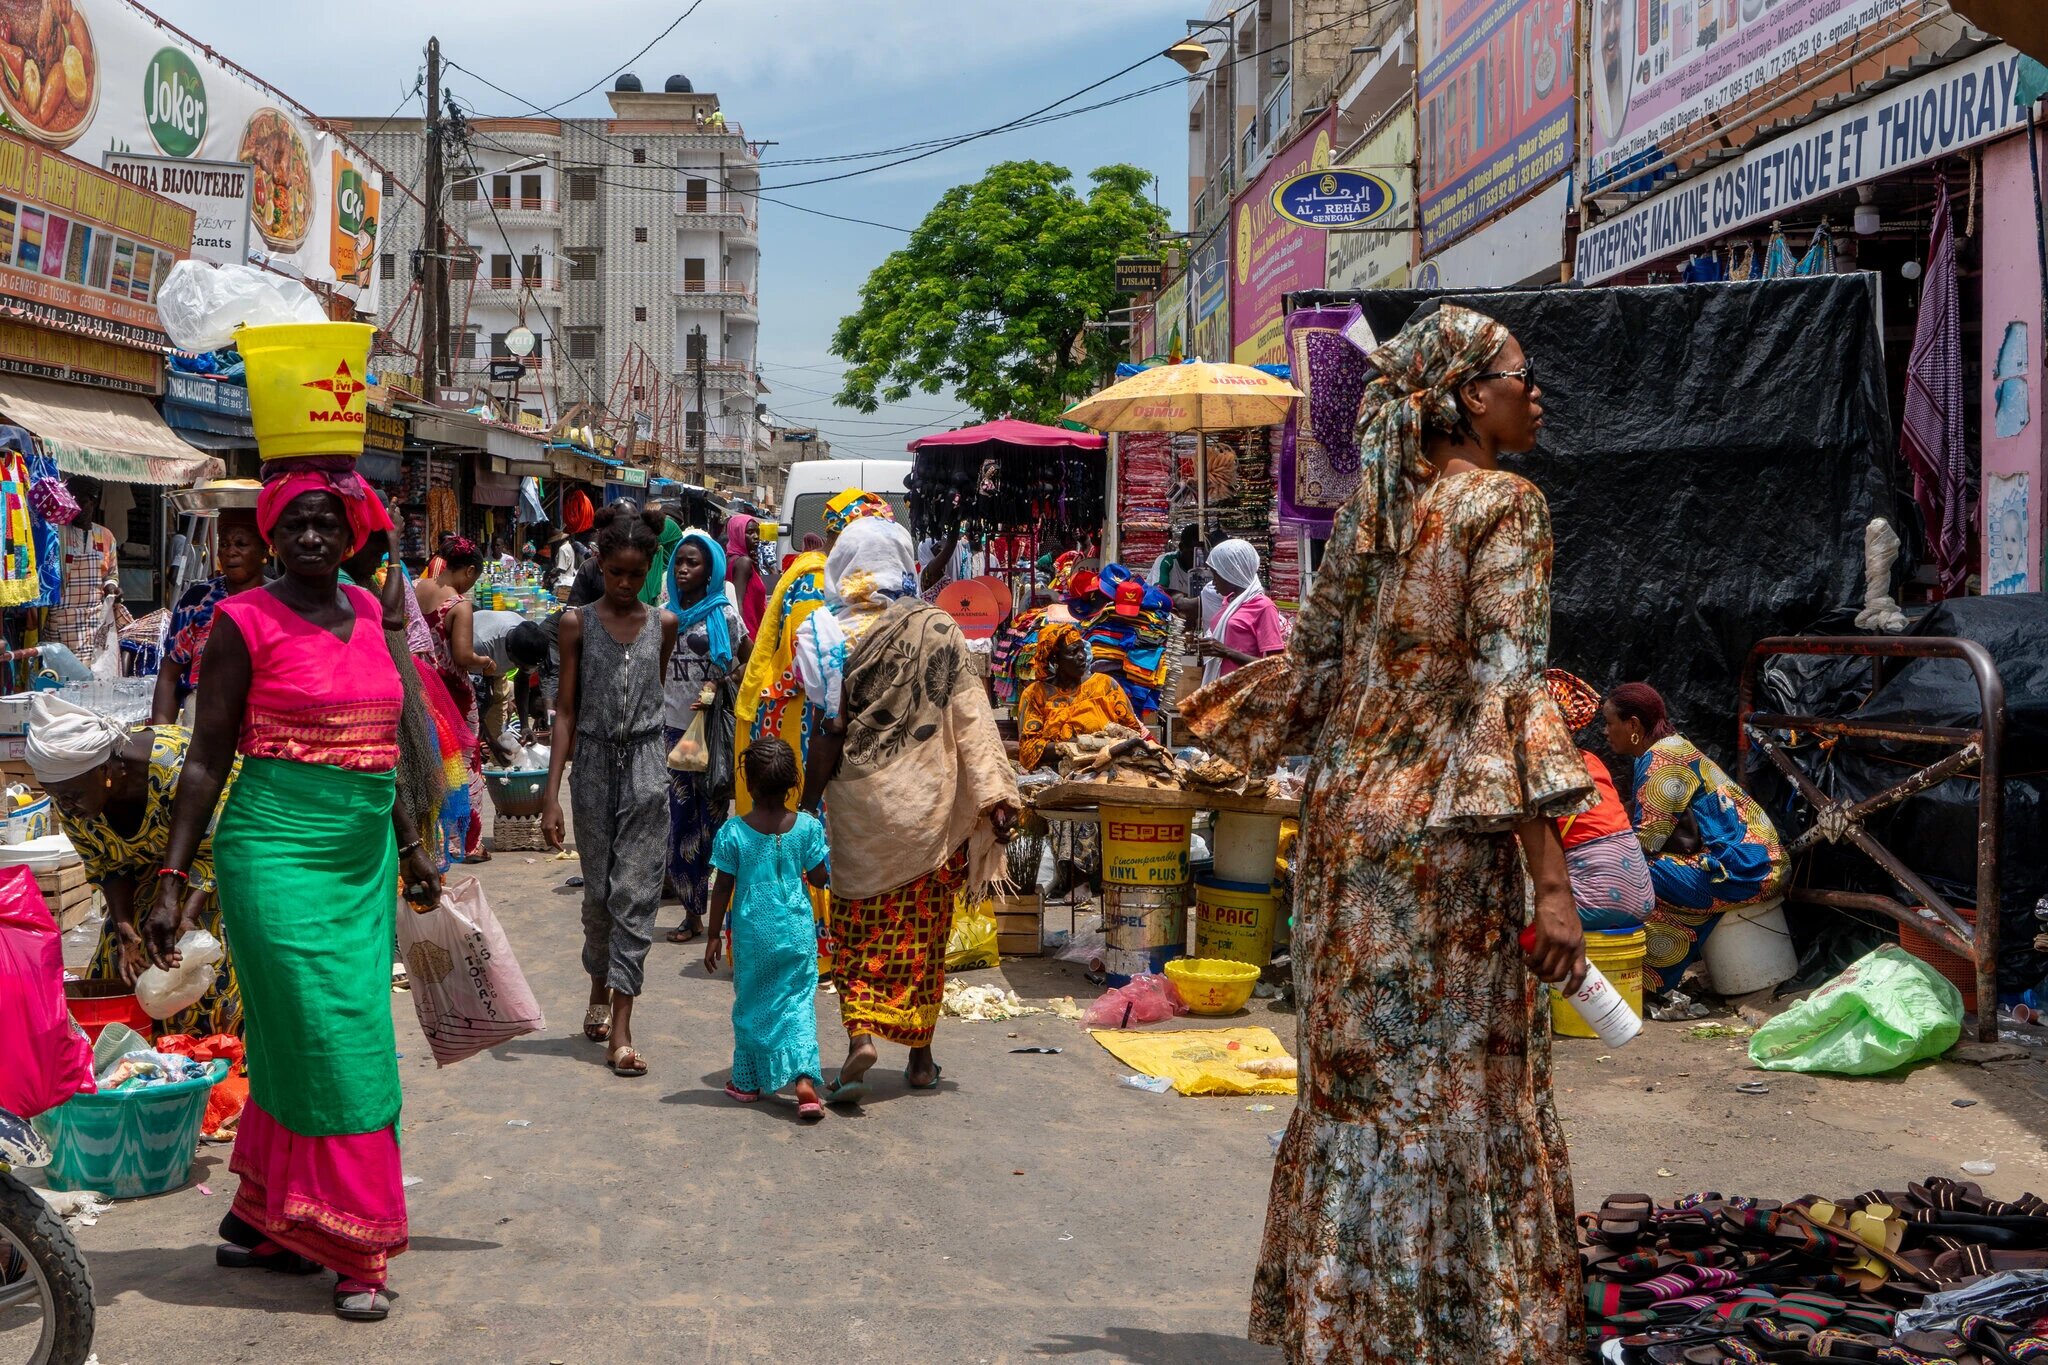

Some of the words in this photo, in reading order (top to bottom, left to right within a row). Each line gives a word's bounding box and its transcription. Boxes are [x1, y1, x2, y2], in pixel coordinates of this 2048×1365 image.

[1681, 80, 1704, 101] Plateau
[1704, 62, 1732, 88] ZamZam
[1737, 38, 1772, 72] Thiouraye
[1778, 23, 1803, 44] Macca
[1810, 0, 1841, 25] Sidiada
[149, 62, 203, 139] Joker
[1611, 144, 1629, 162] Marché
[1648, 129, 1658, 143] Rue
[1677, 106, 1699, 127] Diagne
[1704, 97, 1714, 112] Tel
[1719, 87, 1728, 103] 77
[1729, 78, 1743, 97] 095
[1744, 72, 1753, 89] 57
[1755, 66, 1764, 82] 09
[1771, 56, 1780, 75] 77
[1782, 48, 1797, 69] 376
[1798, 39, 1809, 58] 29
[1812, 32, 1822, 51] 18
[1518, 136, 1538, 163] Dakar
[112, 163, 158, 191] TOUBA
[161, 168, 245, 199] BIJOUTERIE
[1499, 180, 1508, 202] 92
[1508, 174, 1517, 197] 46
[1521, 165, 1530, 187] 33
[1531, 157, 1544, 182] 823
[1544, 150, 1553, 172] 87
[1554, 143, 1564, 165] 53
[1296, 205, 1313, 215] AL
[1325, 203, 1371, 214] REHAB
[1578, 216, 1648, 283] ENTREPRISE
[1650, 182, 1708, 251] MAKINE
[1713, 130, 1834, 230] COSMETIQUE
[1838, 121, 1869, 184] ET
[1313, 214, 1356, 222] SENEGAL
[1117, 265, 1160, 274] BIJOUTERIE
[1122, 277, 1151, 286] L'ISLAM
[10, 275, 37, 296] GENRES
[39, 284, 48, 298] DE
[50, 286, 71, 304] TISSUS
[34, 305, 43, 317] 70
[46, 309, 57, 320] 40
[65, 312, 74, 324] 77
[77, 315, 91, 327] 568
[93, 319, 103, 330] 54
[105, 322, 114, 333] 57
[122, 326, 130, 337] 77
[132, 329, 144, 340] 023
[147, 332, 155, 343] 33
[156, 335, 164, 344] 30
[10, 362, 19, 371] 70
[23, 364, 33, 374] 40
[42, 367, 51, 376] 77
[71, 372, 80, 381] 54
[83, 374, 92, 383] 57
[99, 377, 108, 386] 77
[125, 382, 133, 390] 33
[134, 384, 143, 392] 30
[1209, 376, 1269, 386] JUMBO
[310, 411, 364, 423] MAGGI
[625, 471, 645, 482] Wari
[670, 658, 714, 681] NY
[1113, 850, 1177, 866] l'incomparable
[1109, 865, 1138, 881] VINYL
[1149, 868, 1176, 881] PLUS
[1215, 907, 1254, 925] PAIC
[464, 956, 497, 1020] TODAY?
[1577, 978, 1608, 1002] Stay
